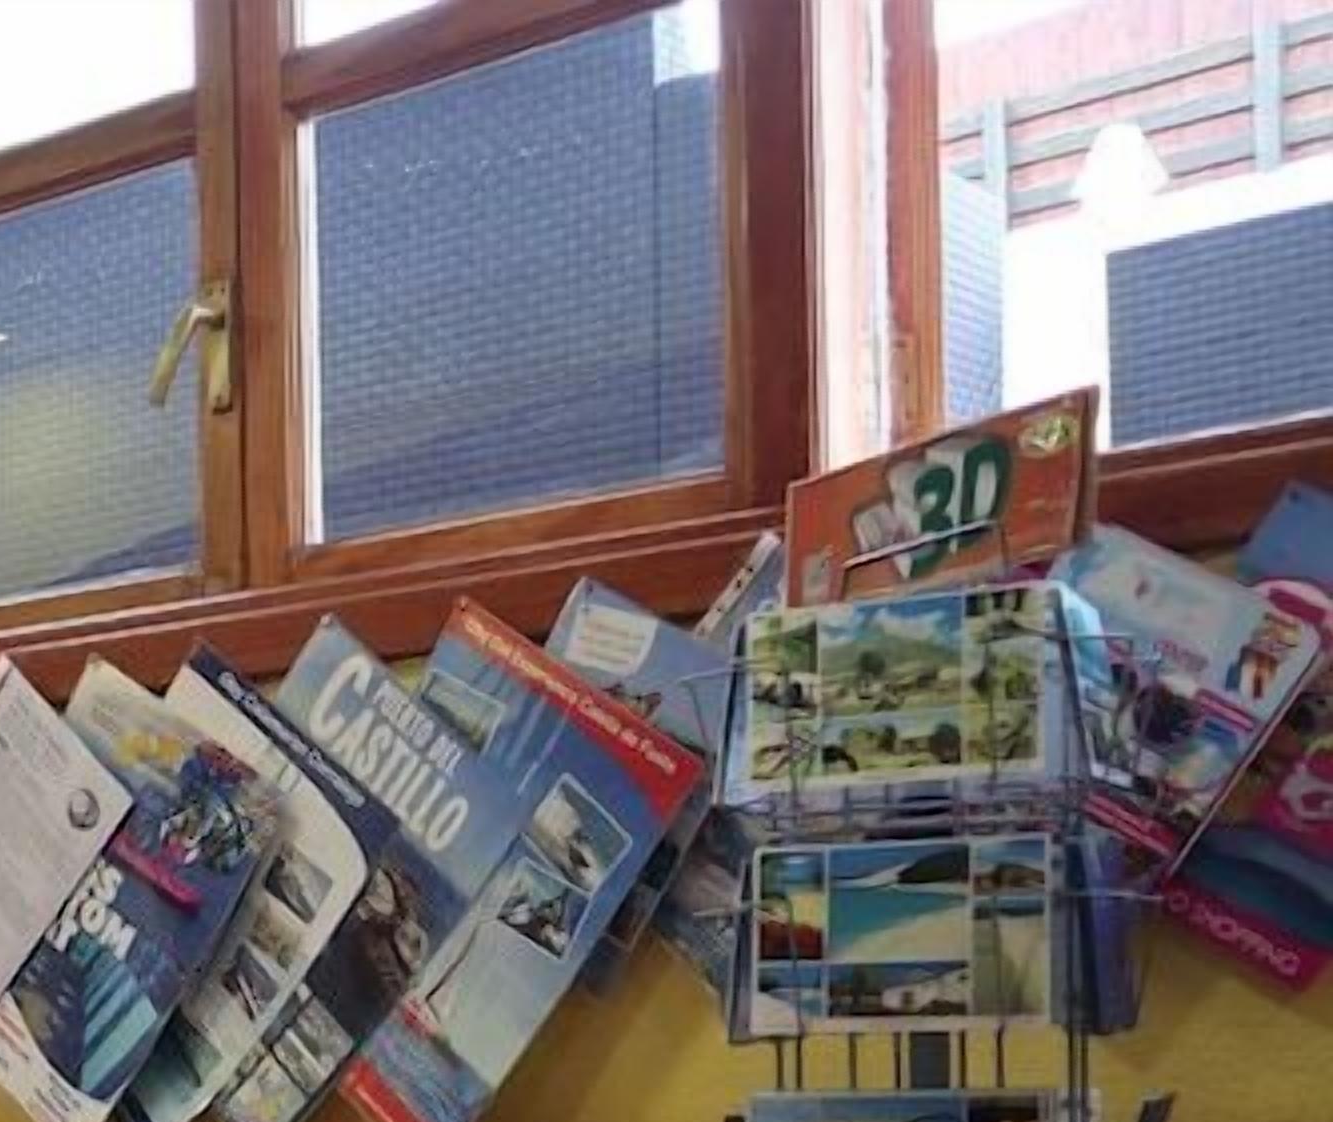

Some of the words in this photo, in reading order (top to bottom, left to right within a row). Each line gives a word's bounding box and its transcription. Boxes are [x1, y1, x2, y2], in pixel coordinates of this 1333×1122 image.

[309, 653, 469, 851] CASTILLO
[371, 680, 434, 750] PUERTO
[428, 734, 464, 782] DEL
